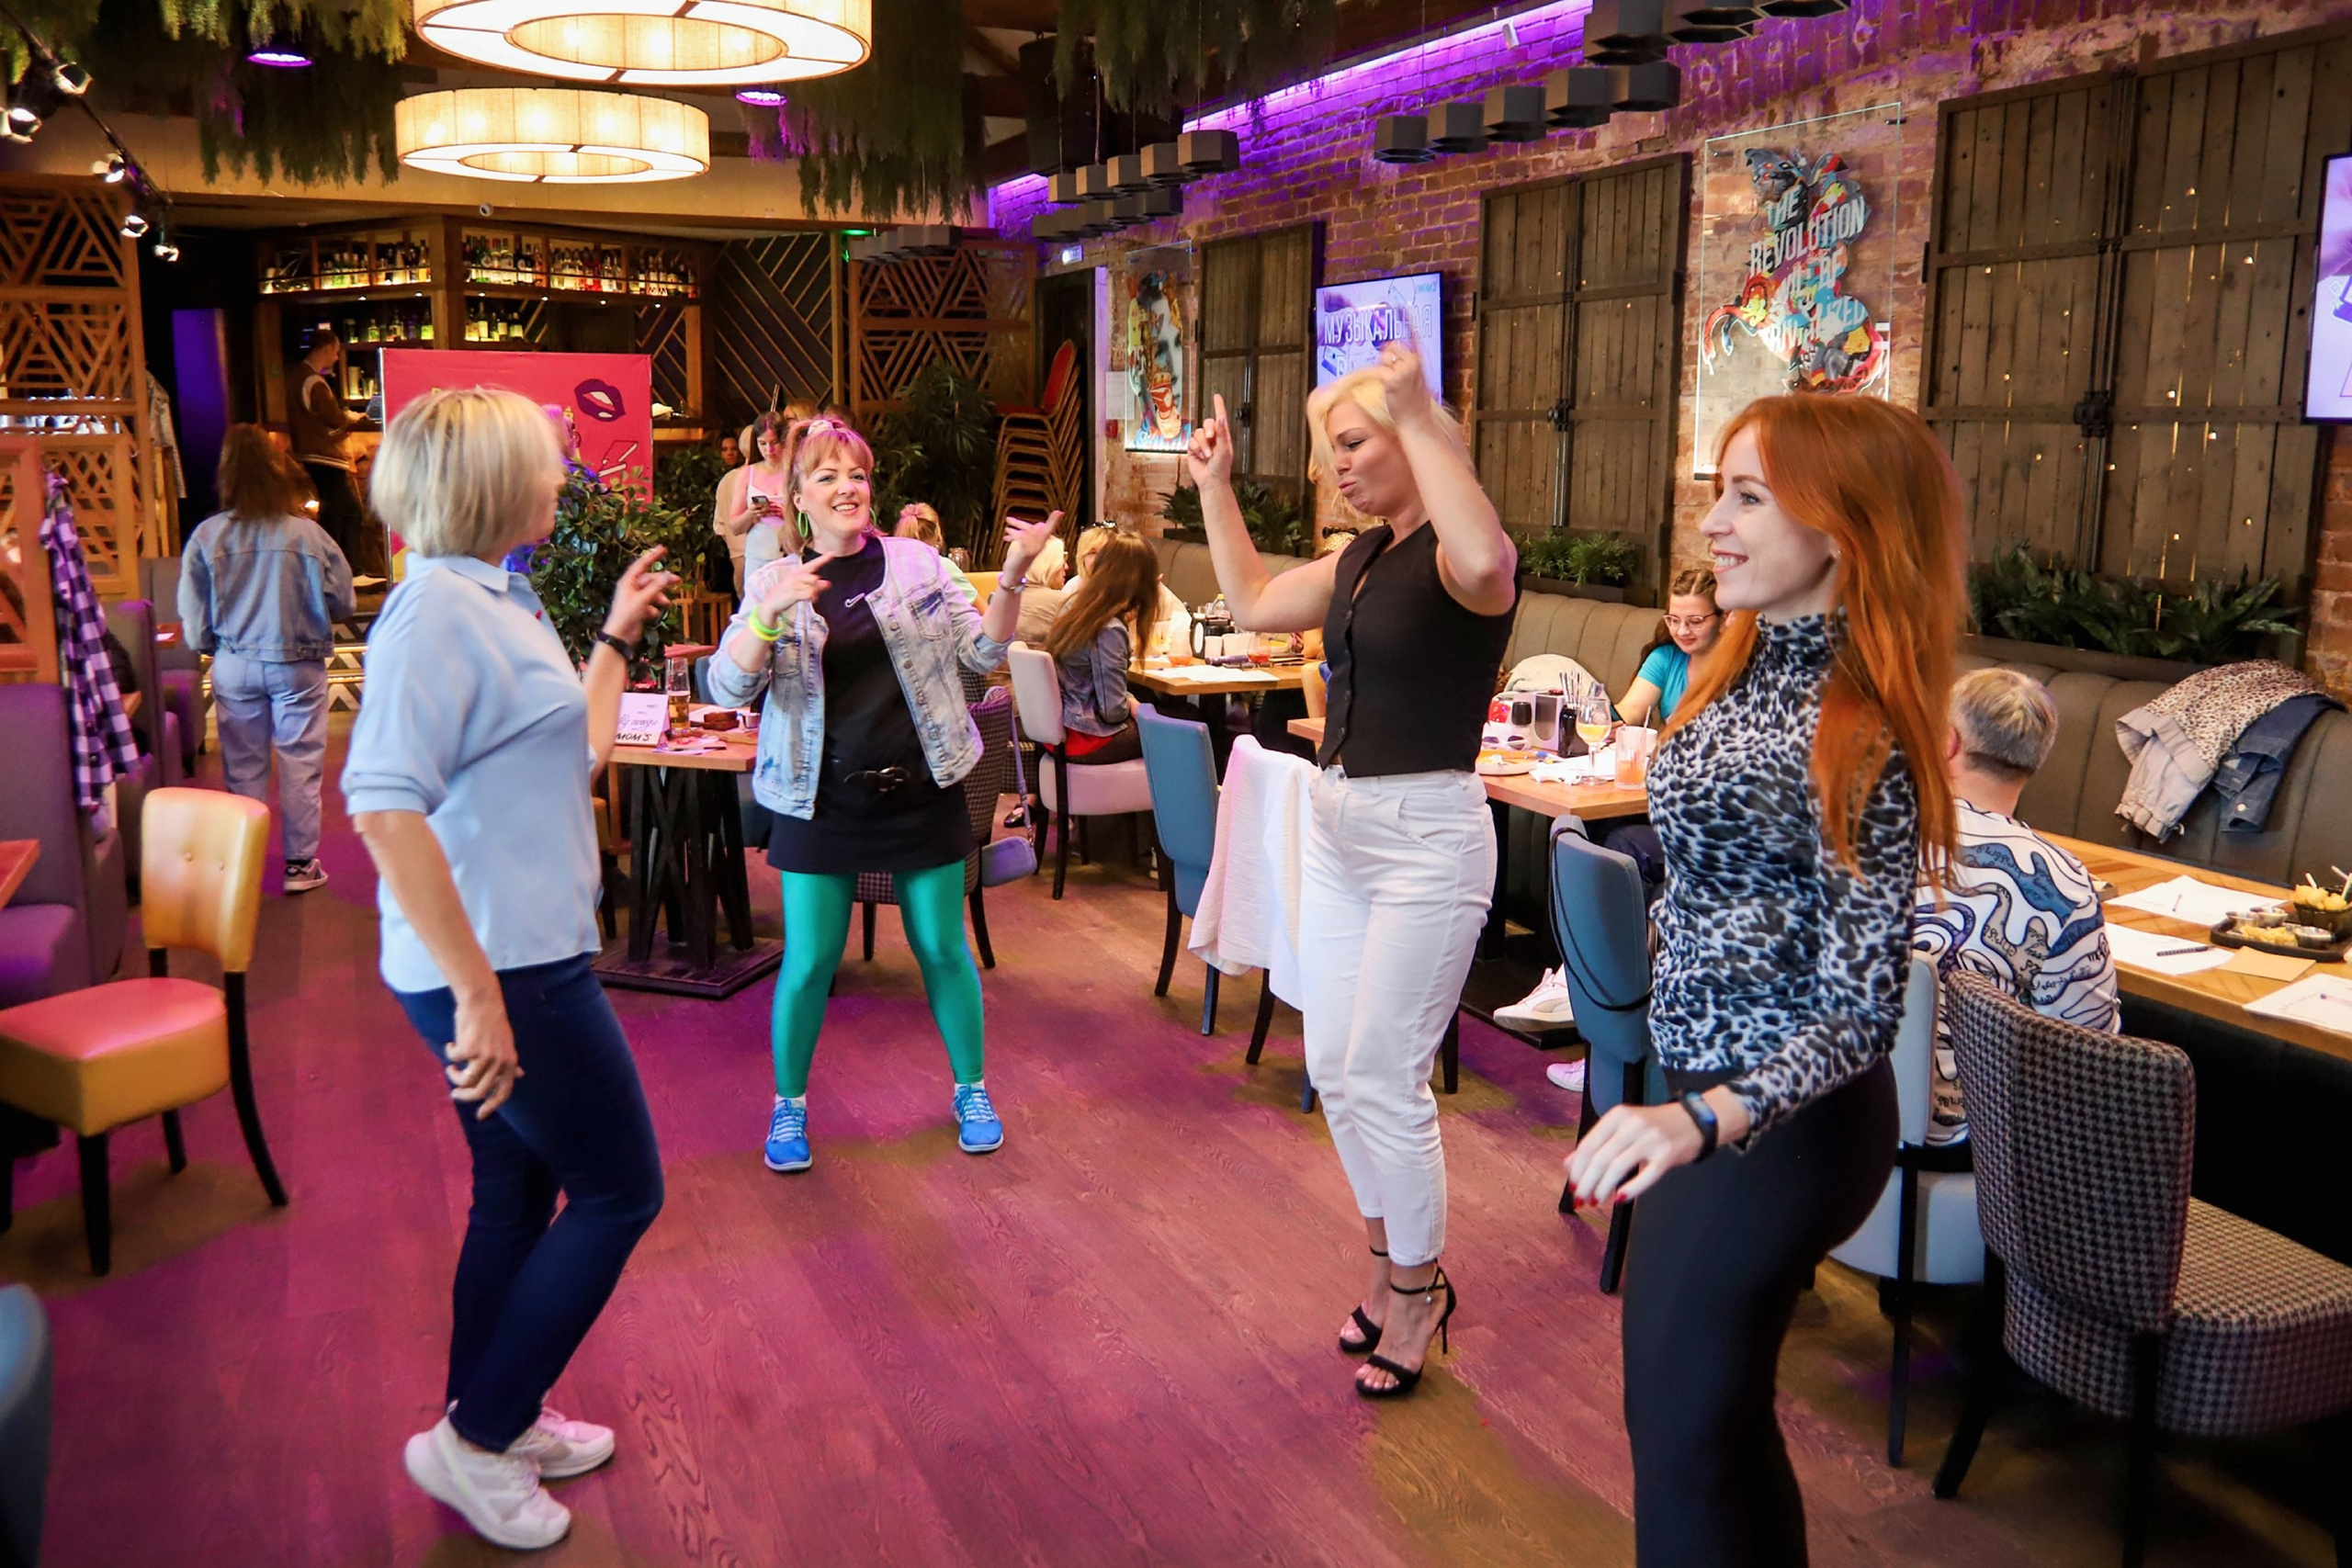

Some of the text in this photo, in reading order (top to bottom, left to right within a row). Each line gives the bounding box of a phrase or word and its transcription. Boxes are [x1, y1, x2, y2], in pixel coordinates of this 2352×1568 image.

[1764, 184, 1802, 226] THE
[1750, 196, 1865, 277] REVOLUTION
[1818, 250, 1843, 291] BE
[1324, 304, 1432, 344] МУЗЫКАЛЬНАЯ
